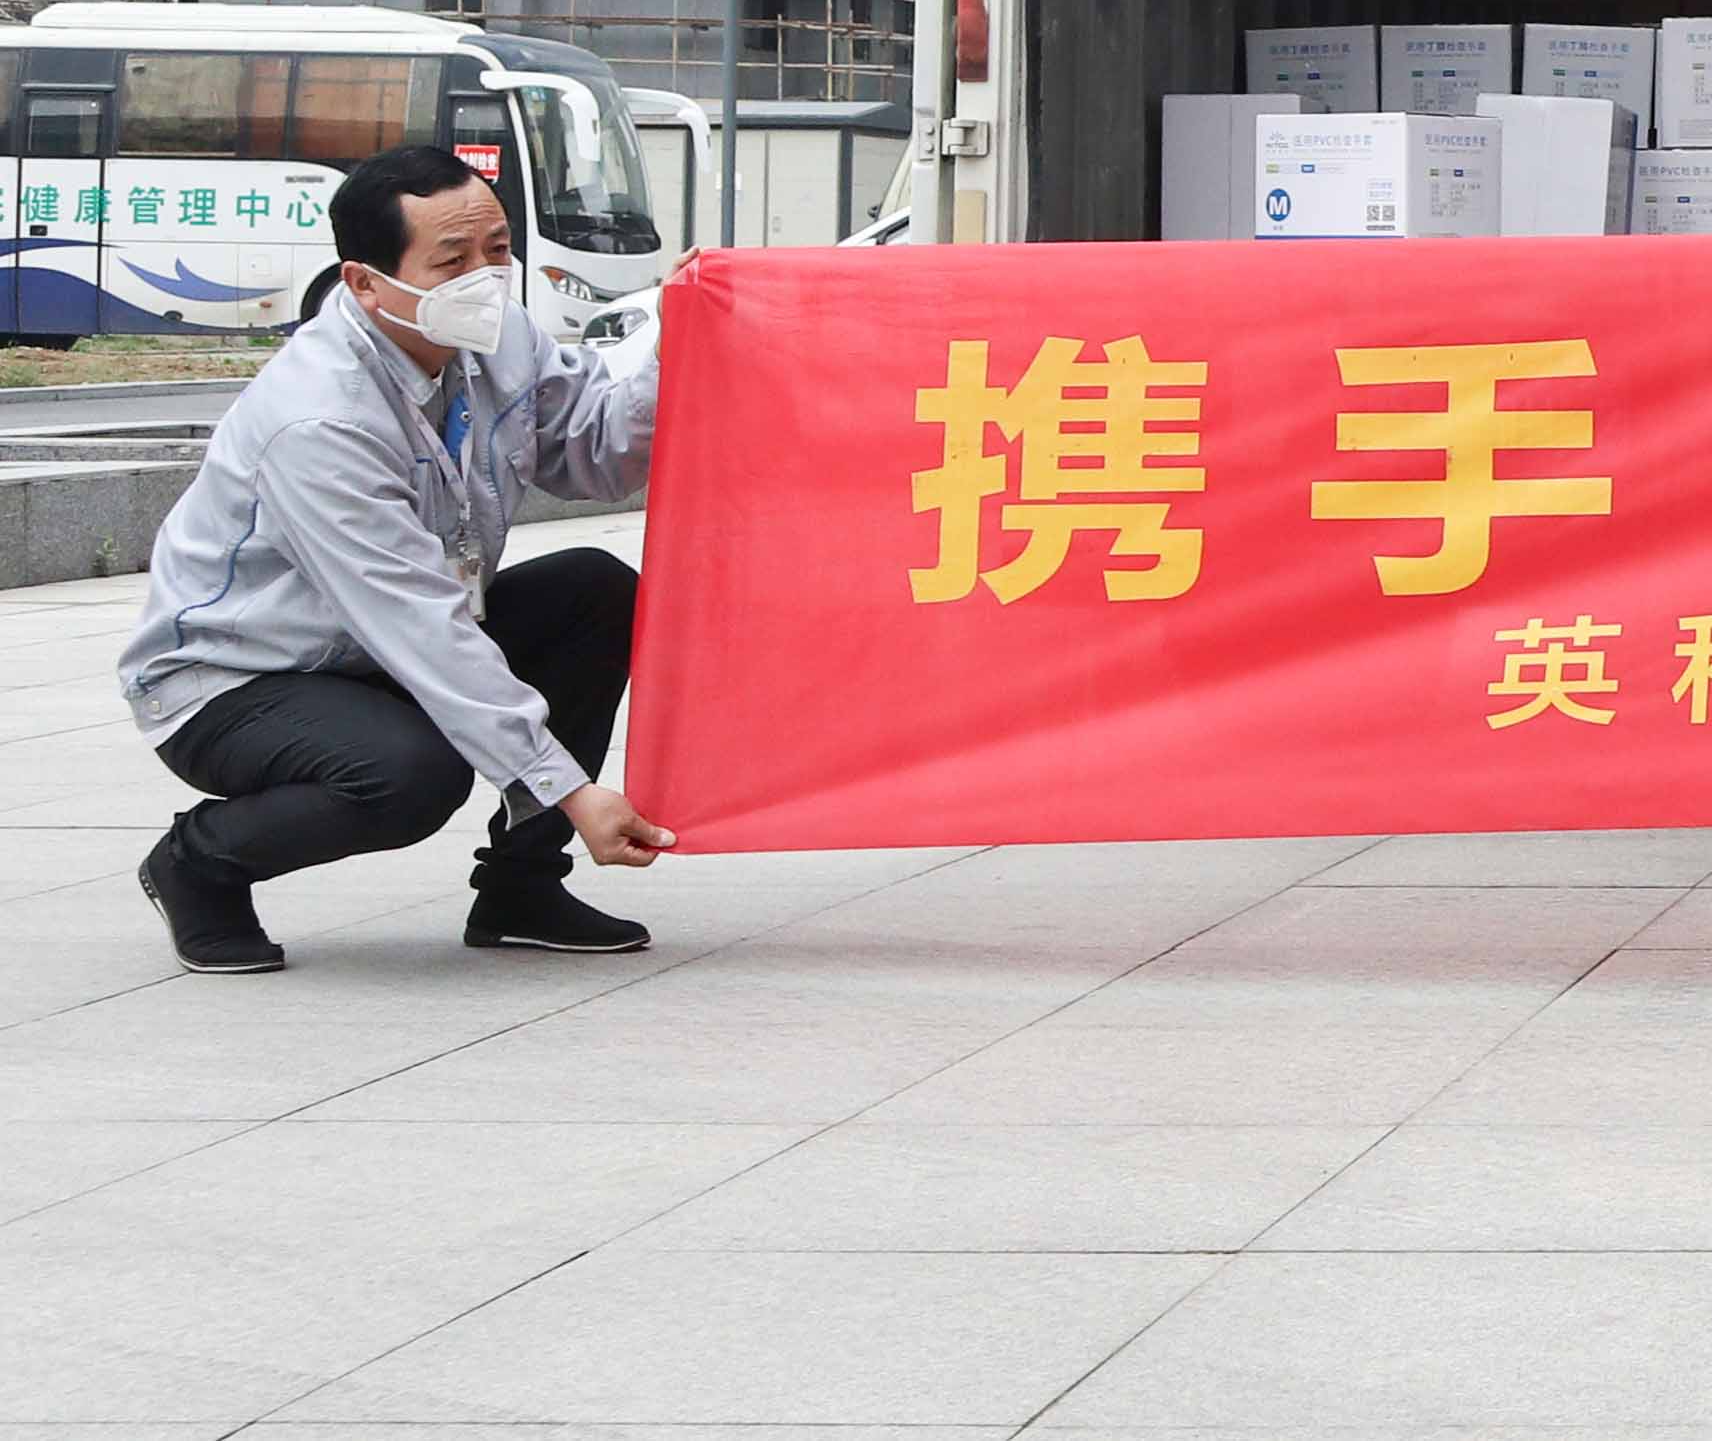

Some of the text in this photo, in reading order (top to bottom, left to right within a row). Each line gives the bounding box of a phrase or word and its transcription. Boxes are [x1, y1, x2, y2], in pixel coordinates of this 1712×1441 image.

[0, 184, 323, 227] 健康管理中心
[1269, 196, 1289, 215] M
